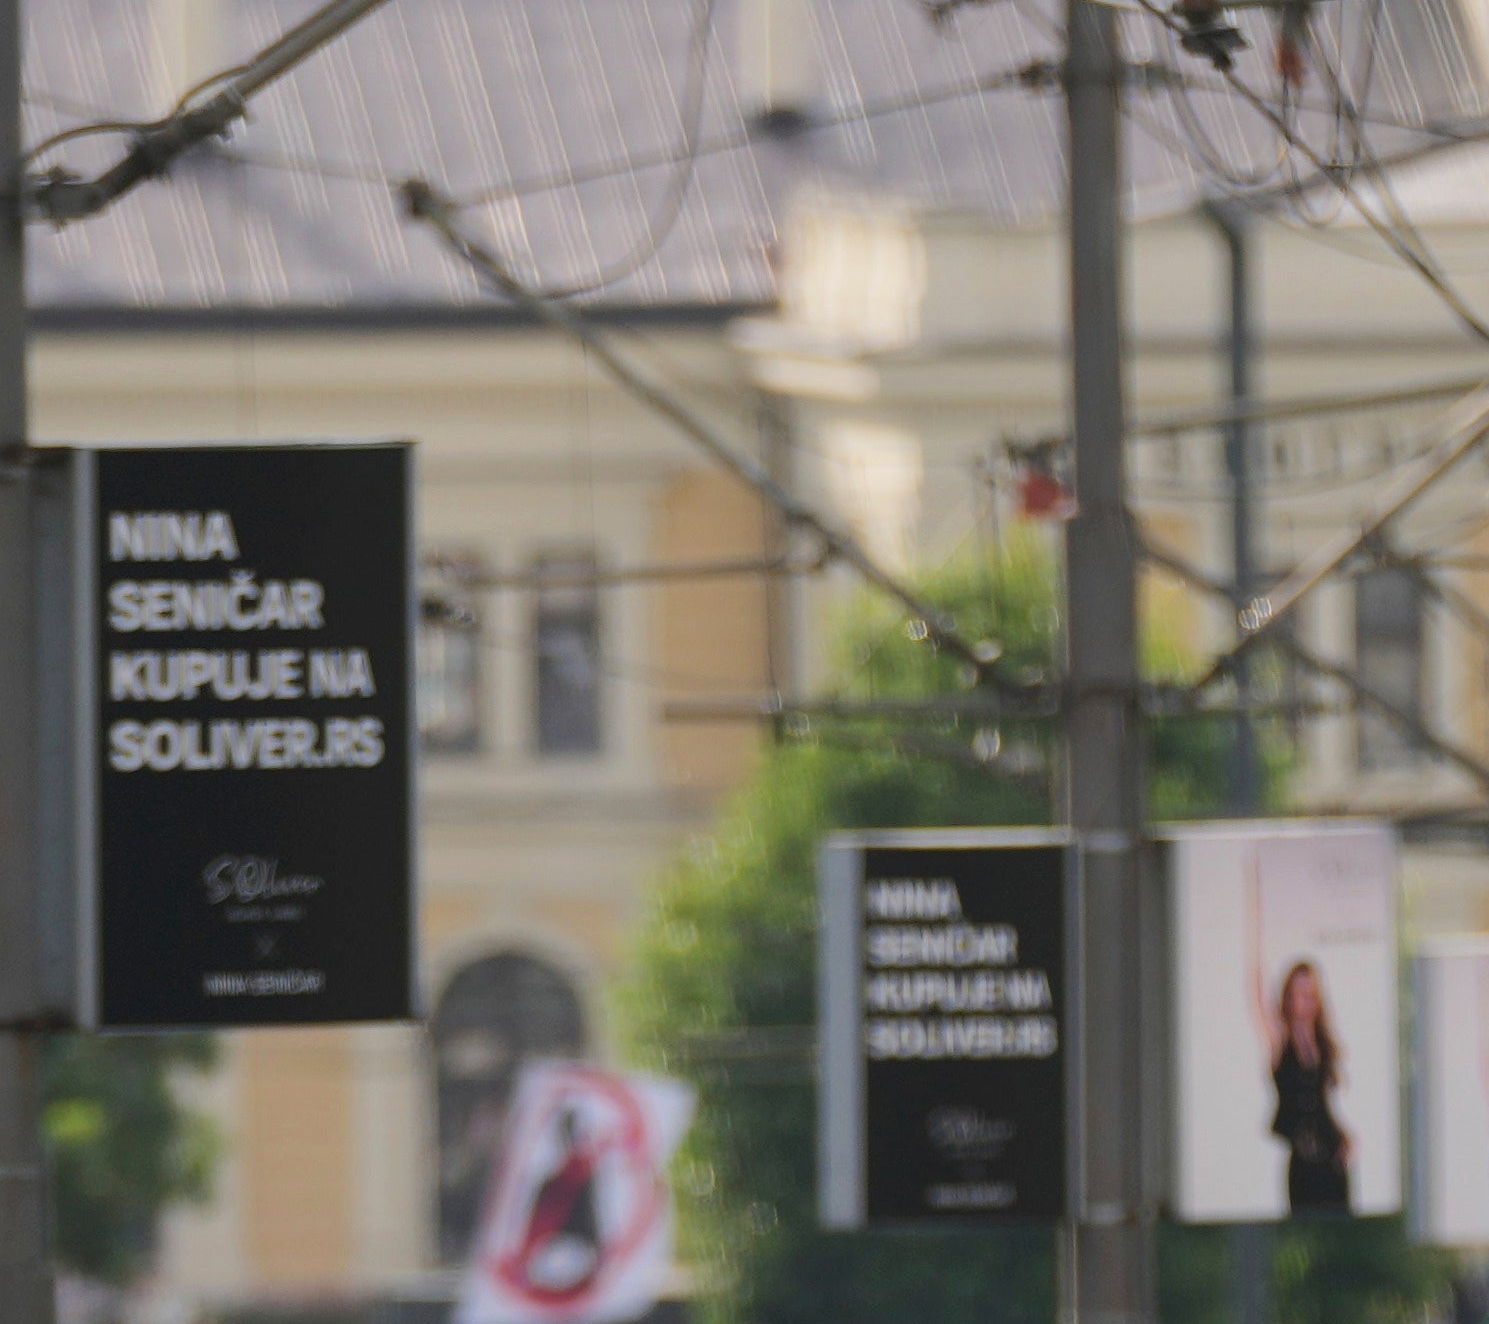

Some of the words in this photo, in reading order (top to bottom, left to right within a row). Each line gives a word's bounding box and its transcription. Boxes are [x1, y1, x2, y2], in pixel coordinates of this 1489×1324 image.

[109, 511, 239, 561] NINA
[108, 568, 325, 632] SENIČAR
[108, 648, 303, 702] KUPUJE
[309, 647, 377, 698] NA
[108, 716, 386, 772] SOLIVER.RS
[867, 876, 963, 921] NINA
